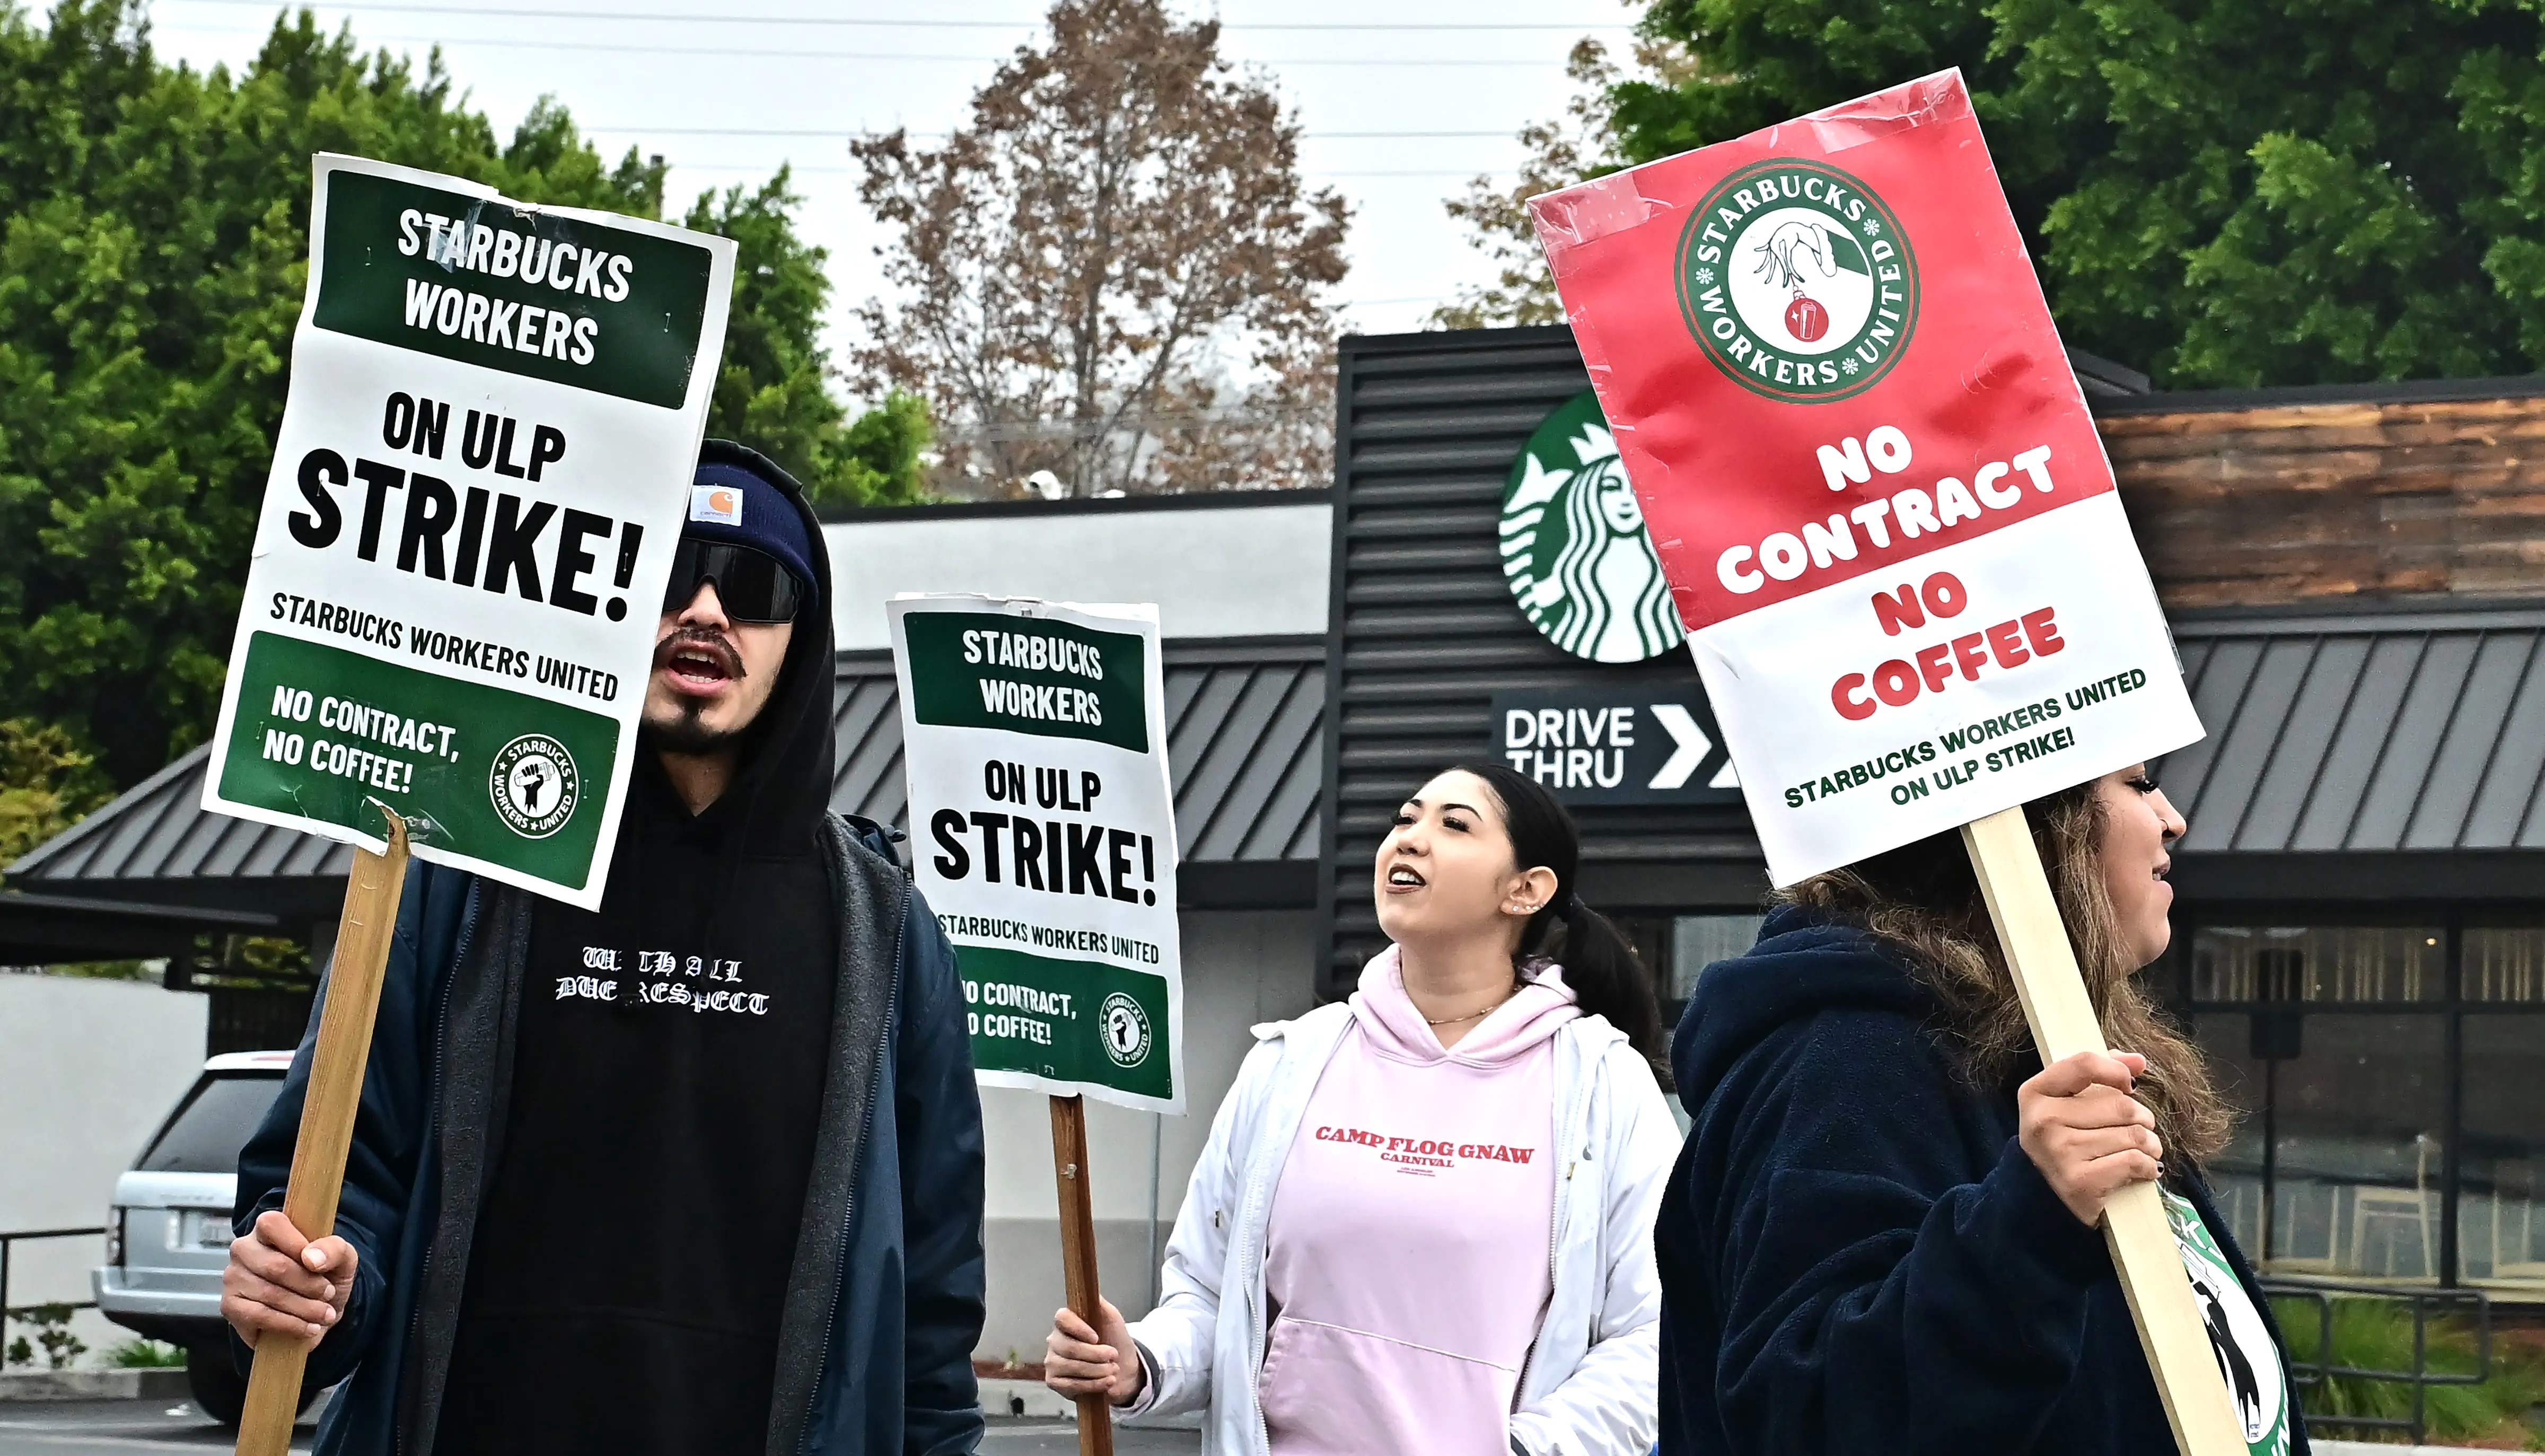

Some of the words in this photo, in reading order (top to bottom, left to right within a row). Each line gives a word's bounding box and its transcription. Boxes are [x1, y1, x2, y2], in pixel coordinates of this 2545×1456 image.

[1697, 175, 1866, 264] STARBUCKS
[398, 209, 633, 302] STARBUCKS
[406, 278, 598, 365] WORKERS
[1855, 239, 1902, 364] UNITED
[1700, 285, 1838, 385] WORKERS
[383, 391, 450, 460] ON
[461, 409, 566, 483] ULP
[1816, 425, 1912, 491] NO
[288, 448, 644, 622] STRIKE!
[1716, 444, 2054, 594] CONTRACT
[1871, 571, 1967, 636] NO
[270, 592, 403, 648] STARBUCKS
[411, 626, 529, 678] WORKERS
[536, 655, 618, 701] UNITED
[962, 630, 1103, 680] STARBUCKS
[1831, 606, 2065, 720] COFFEE
[271, 685, 313, 722] NO
[319, 696, 460, 763] CONTRACT,
[979, 679, 1102, 726] WORKERS
[1505, 706, 1635, 748] DRIVE
[262, 729, 304, 766] NO
[310, 740, 414, 794] COFFEE!
[508, 741, 572, 777] STARBUCKS
[1785, 741, 1936, 809] STARBUCKS
[1940, 698, 2061, 753] WORKERS
[2065, 668, 2146, 711] UNITED
[1890, 777, 1929, 805] ON
[1933, 759, 1979, 790] ULP
[1987, 726, 2075, 772] STRIKE!
[985, 760, 1026, 805] ON
[1035, 767, 1101, 812] ULP
[1505, 748, 1624, 789] THRU
[495, 774, 529, 828] WORKERS
[539, 795, 572, 830] UNITED
[931, 809, 1156, 907] STRIKE!
[937, 914, 1028, 942] STARBUCKS
[1032, 926, 1108, 953] WORKERS
[1112, 936, 1160, 964] UNITED
[556, 976, 618, 1001] DUE
[961, 980, 979, 1004] O
[984, 983, 1077, 1021] CONTRACT,
[1106, 997, 1143, 1022] STARBUCKS
[967, 1012, 979, 1036] O
[984, 1015, 1051, 1045] COFFEE!
[1102, 1023, 1124, 1061] WORKERS
[1130, 1034, 1148, 1061] UNITED
[1315, 1126, 1384, 1148] CAMP
[1386, 1137, 1454, 1156] FLOG
[1458, 1144, 1535, 1164] GNAW
[1381, 1152, 1454, 1168] CARNIVAL
